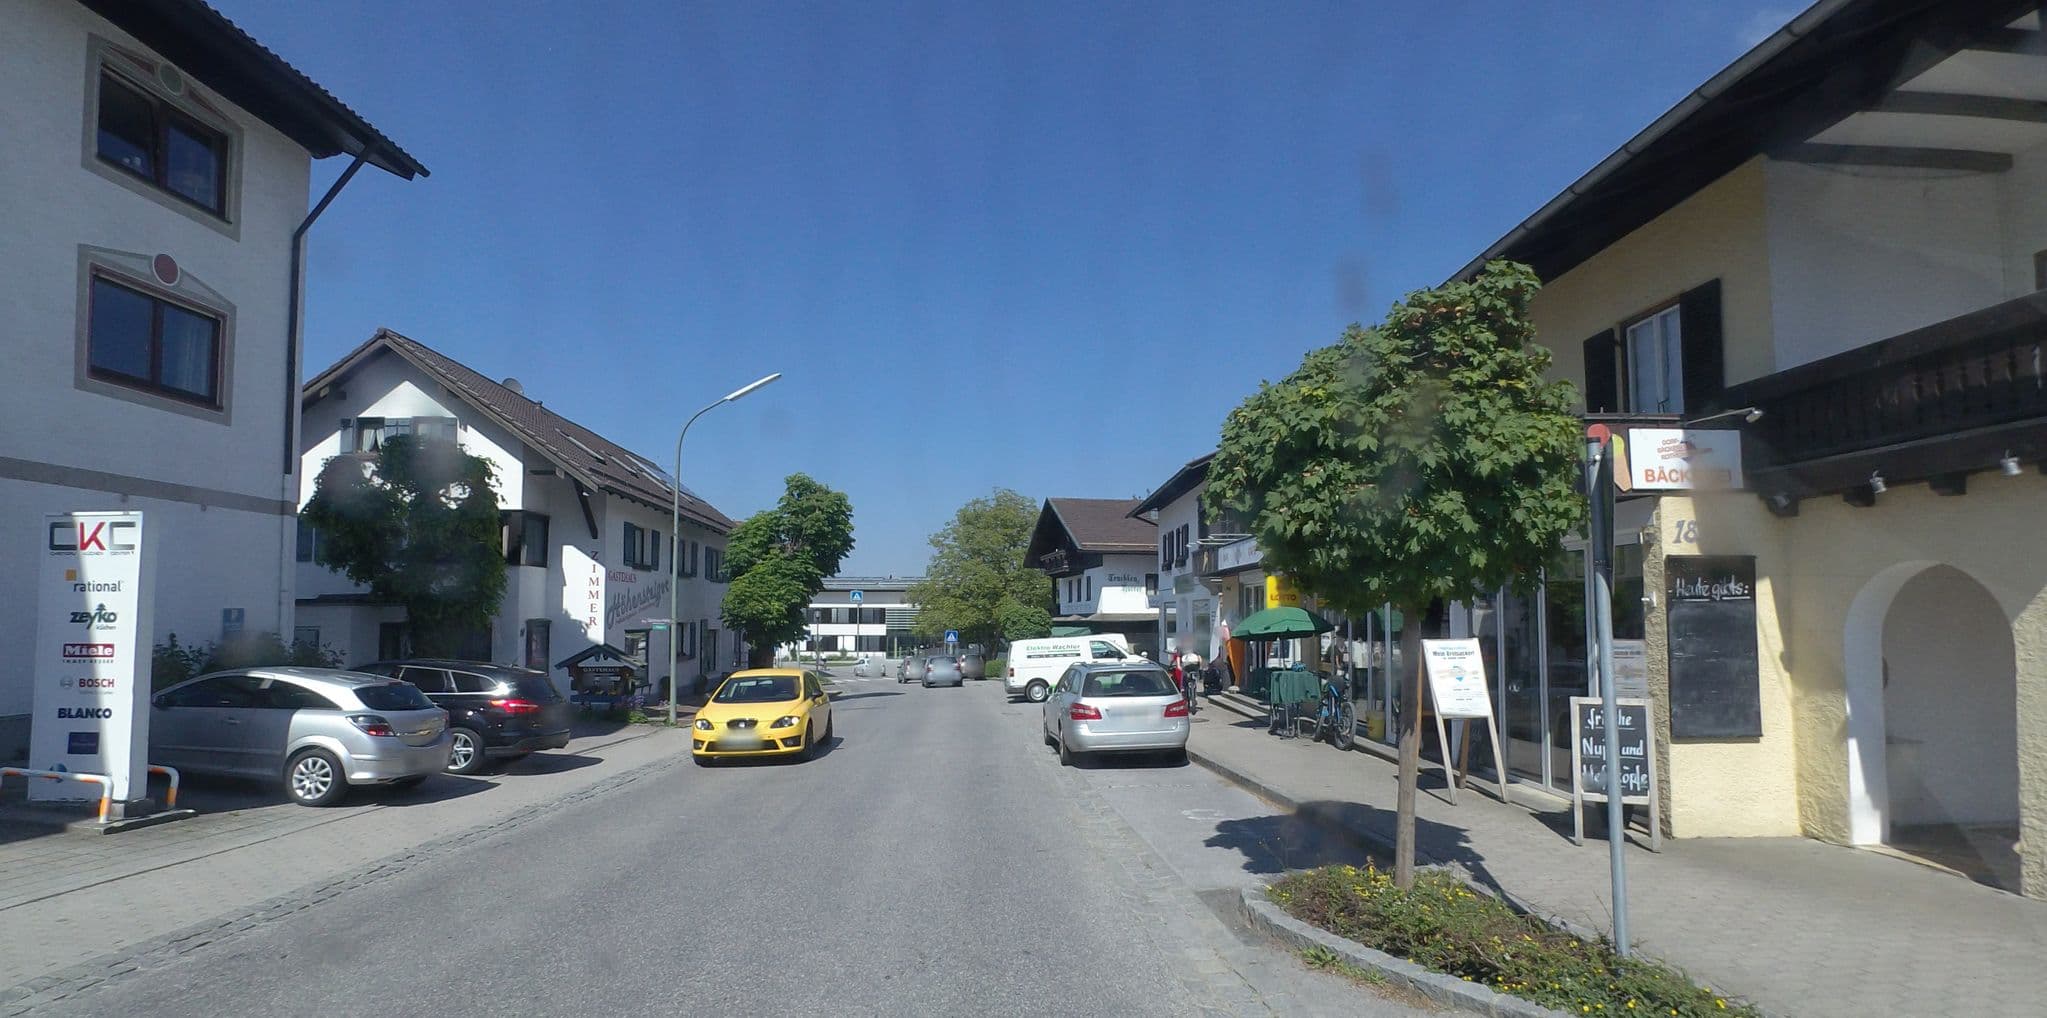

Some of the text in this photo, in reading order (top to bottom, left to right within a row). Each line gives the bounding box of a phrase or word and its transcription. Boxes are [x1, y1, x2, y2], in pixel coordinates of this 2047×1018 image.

[49, 522, 136, 550] CKC
[1672, 519, 1698, 544] 18
[73, 580, 121, 592] rational
[588, 550, 600, 626] ZIMMER
[70, 603, 117, 630] zeyko
[64, 645, 113, 656] Miele
[79, 678, 115, 688] BOSCH
[58, 708, 112, 718] BLANCO
[1587, 708, 1632, 730] frihe
[1621, 739, 1644, 756] und
